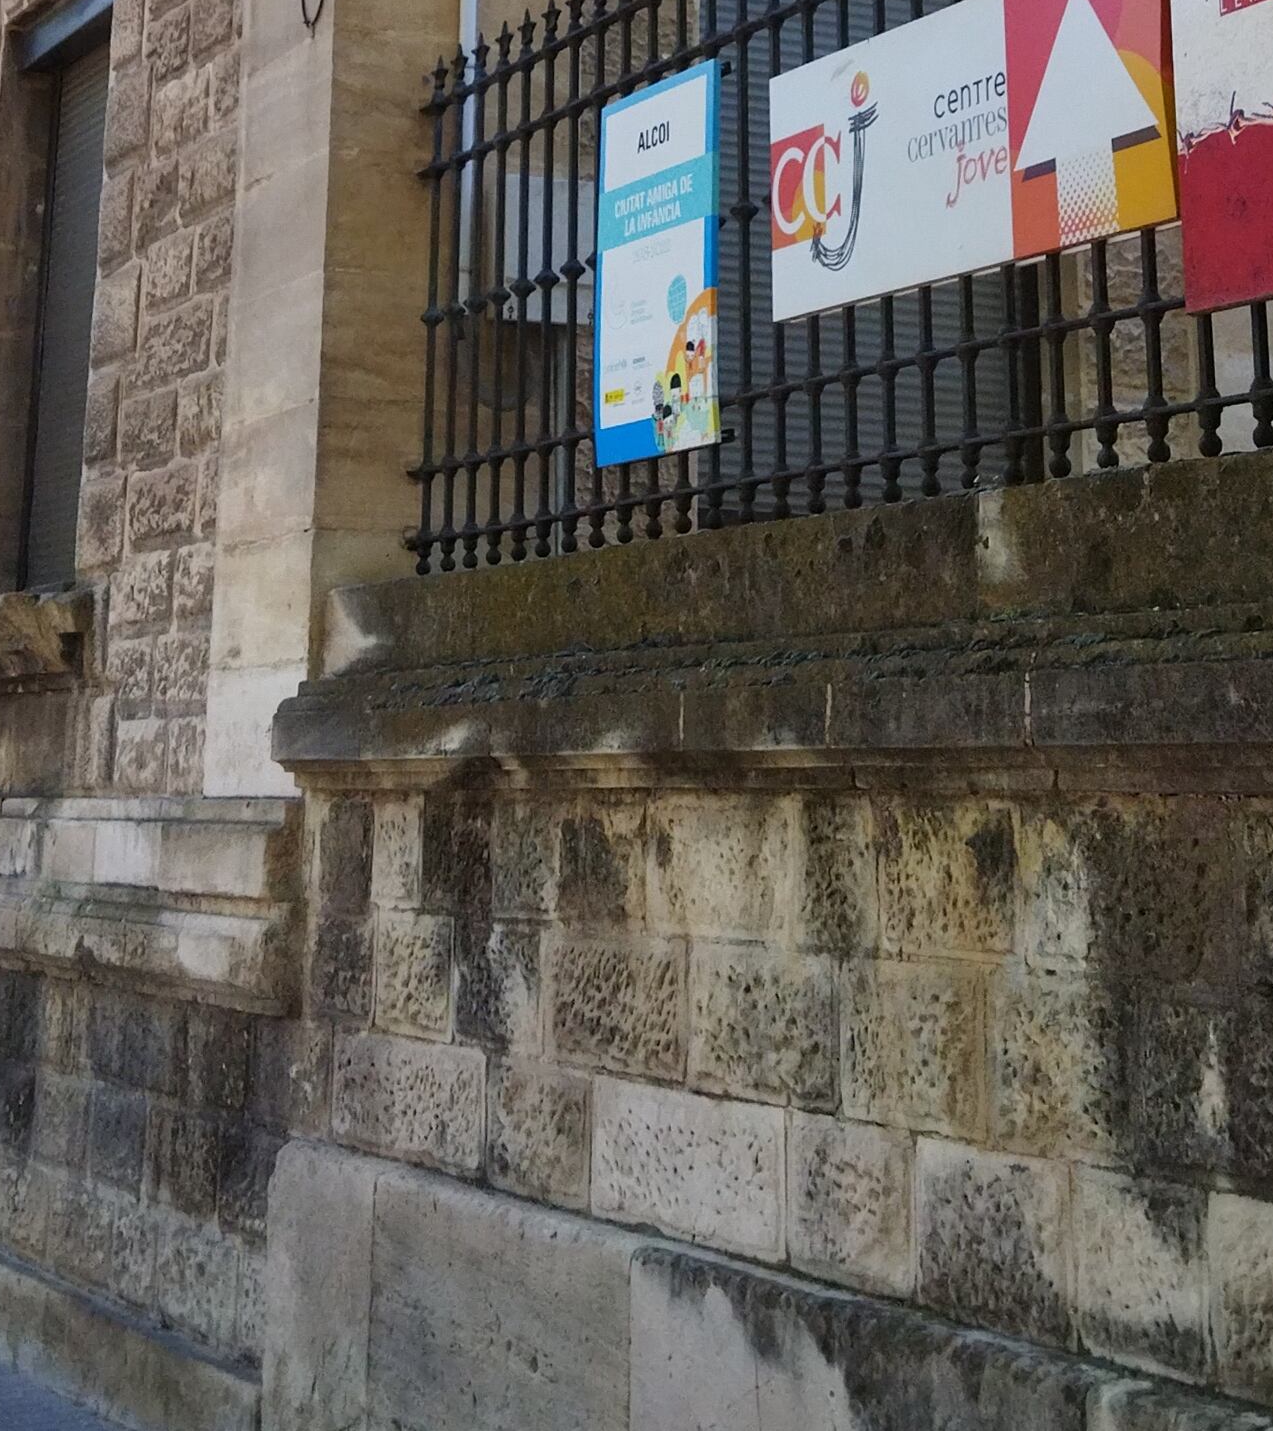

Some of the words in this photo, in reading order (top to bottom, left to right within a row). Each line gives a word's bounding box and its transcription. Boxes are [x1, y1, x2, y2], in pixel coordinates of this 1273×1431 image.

[637, 120, 670, 154] ALCOI
[945, 140, 1008, 209] jove
[614, 191, 646, 219] CIUTAT
[646, 180, 679, 207] AMIGA
[680, 173, 694, 194] DE
[624, 217, 636, 237] LA
